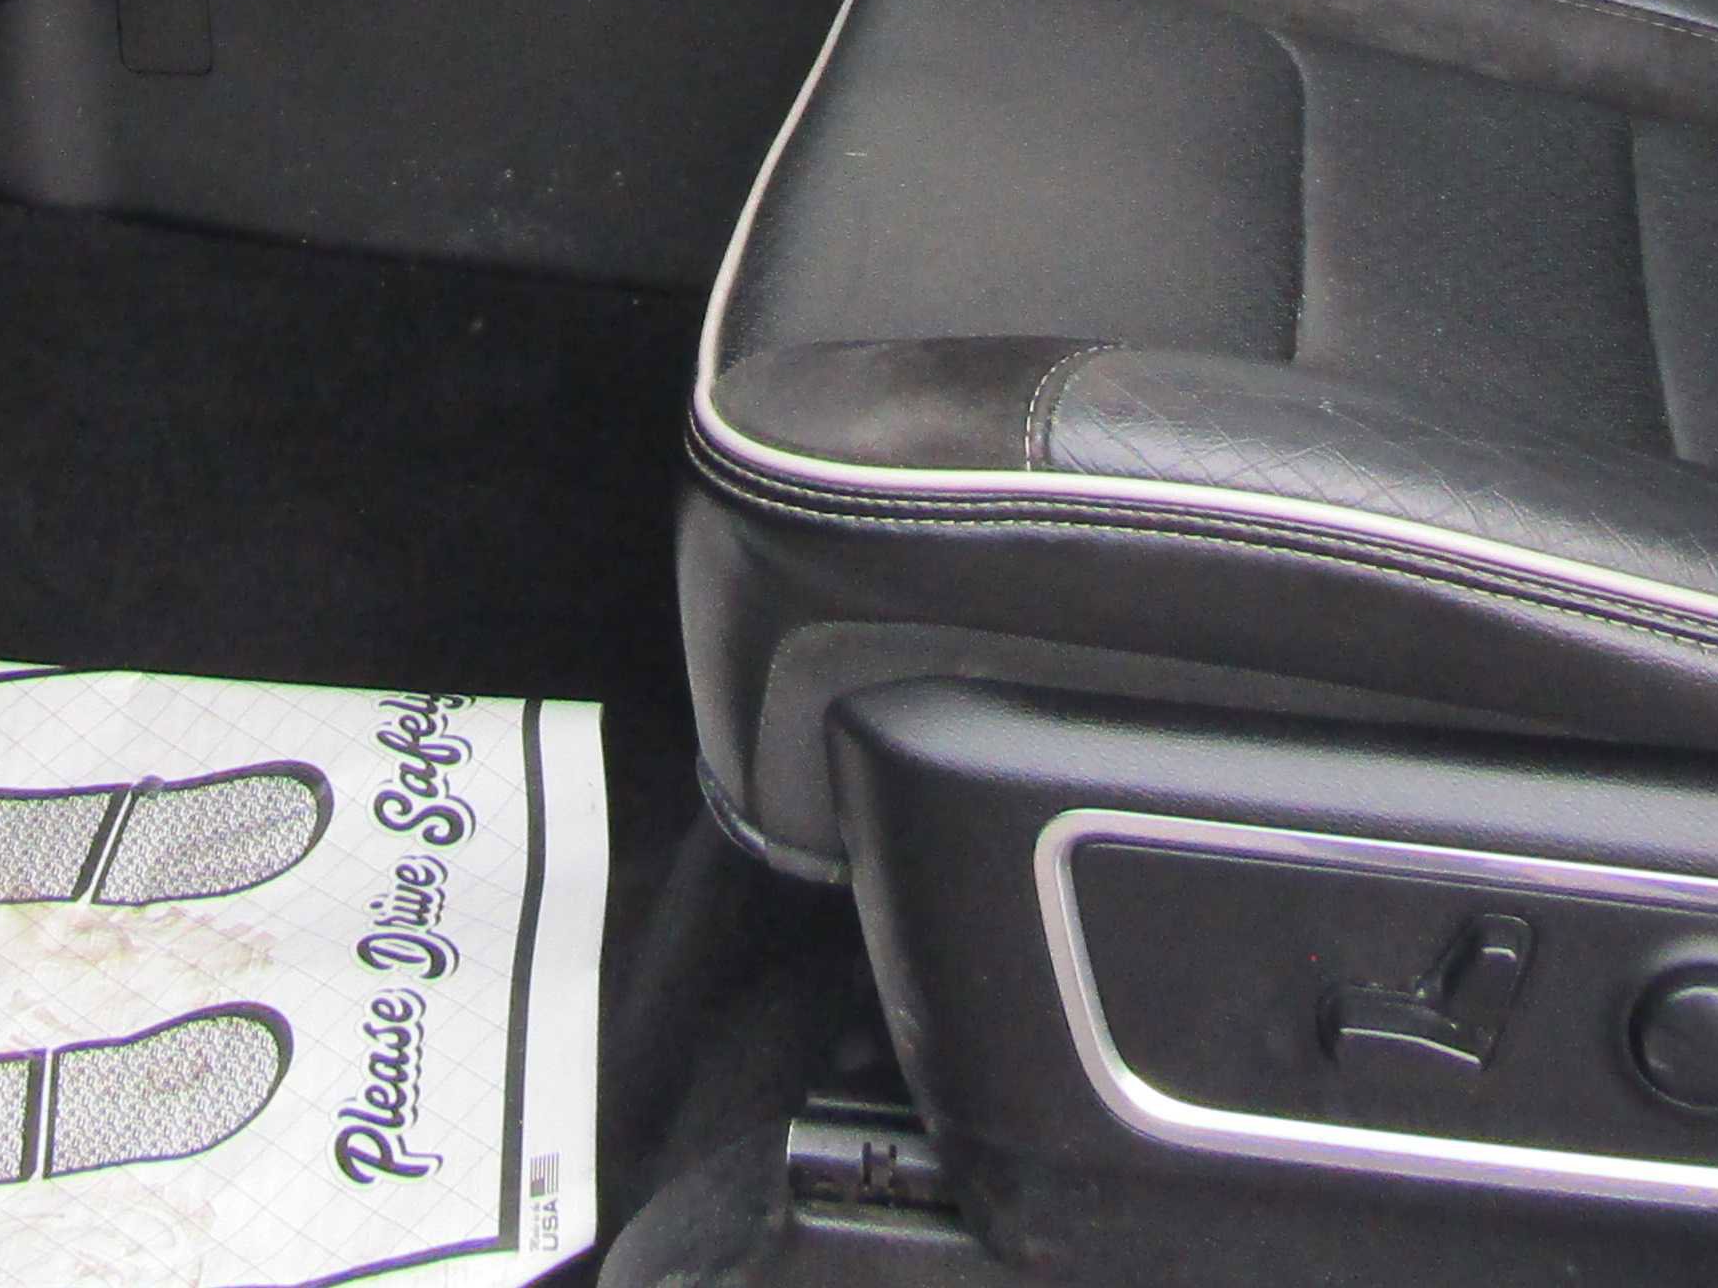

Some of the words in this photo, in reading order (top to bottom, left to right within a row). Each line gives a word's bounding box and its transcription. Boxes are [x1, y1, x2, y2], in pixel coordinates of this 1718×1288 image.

[356, 863, 448, 980] Drive
[334, 995, 431, 1185] Please
[543, 1198, 559, 1252] USA
